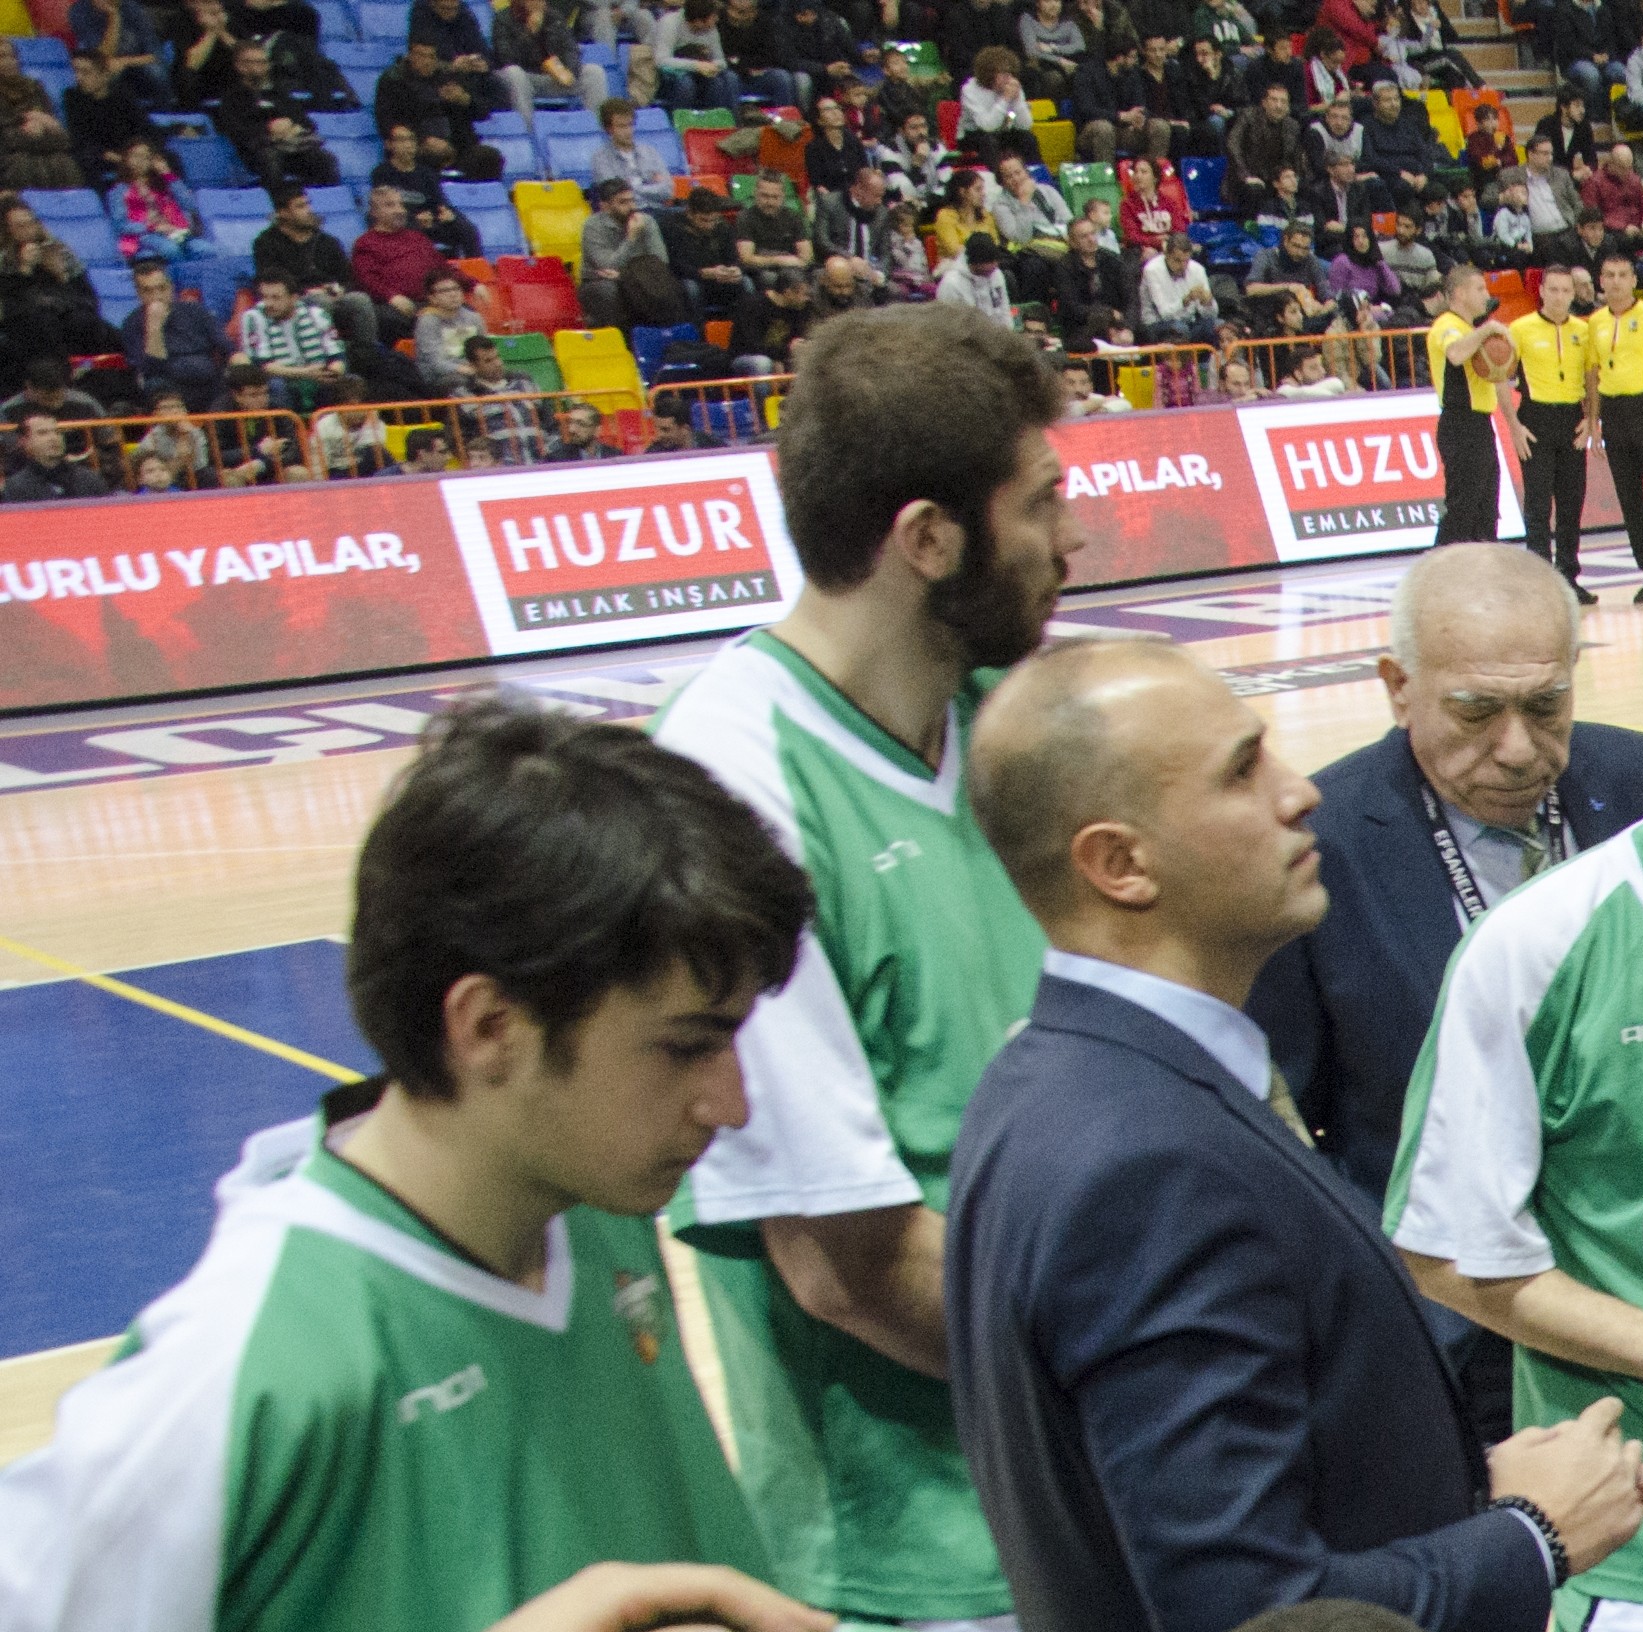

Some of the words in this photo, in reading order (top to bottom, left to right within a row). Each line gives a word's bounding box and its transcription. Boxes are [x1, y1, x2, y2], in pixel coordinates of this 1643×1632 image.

[1065, 453, 1224, 499] APILAR,
[1283, 432, 1440, 491] HUZU
[500, 498, 753, 573] HUZUR
[1303, 504, 1387, 535] EMLAK
[165, 531, 422, 589] YAPILAR,
[523, 592, 635, 624] EMLAK
